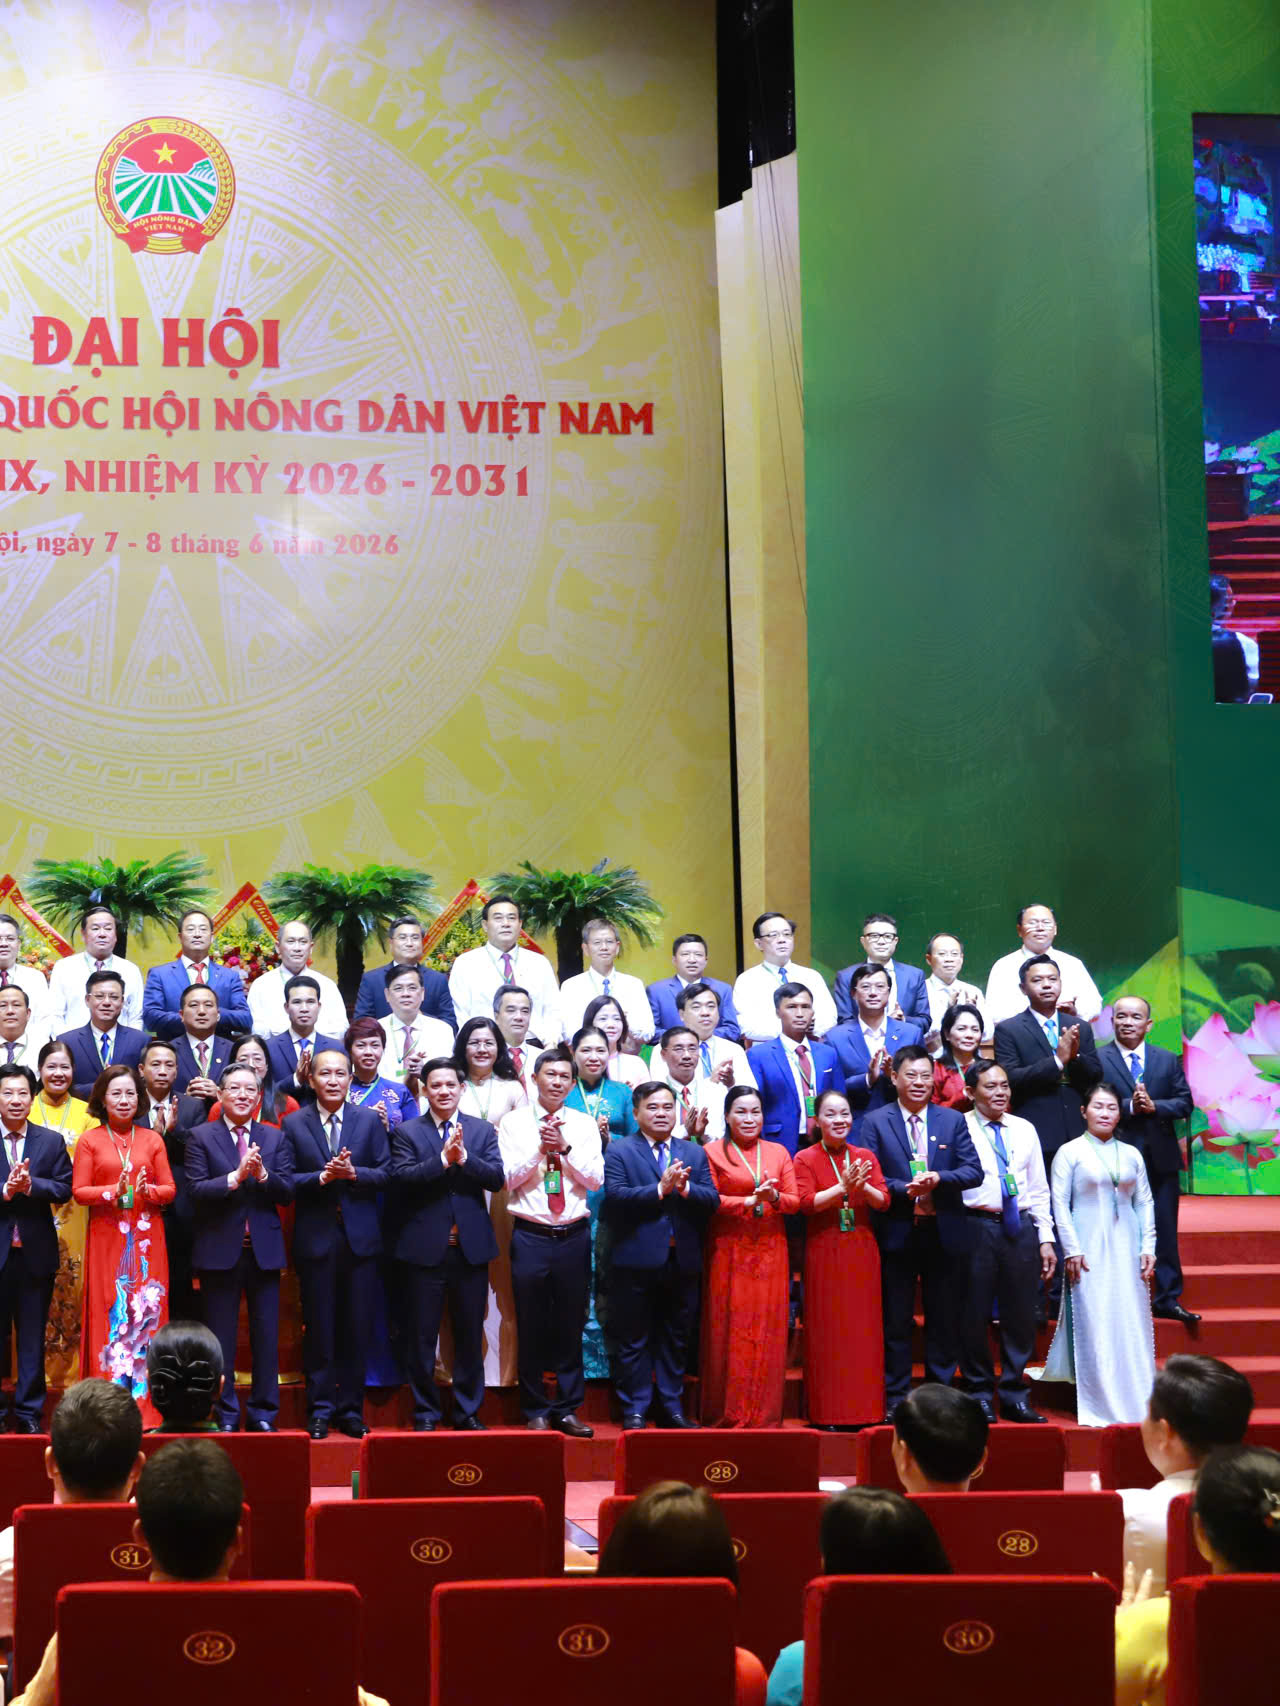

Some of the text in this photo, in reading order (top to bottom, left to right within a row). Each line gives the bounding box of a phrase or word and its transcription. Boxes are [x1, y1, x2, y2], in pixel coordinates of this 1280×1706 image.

[165, 223, 185, 232] NAM
[30, 306, 281, 380] ĐẠI HỘI
[123, 389, 201, 438] HỘI
[214, 391, 345, 433] NÔNG
[359, 392, 446, 433] DÂN
[458, 393, 548, 441] VIỆT
[558, 400, 655, 436] NAM
[64, 452, 200, 501] NHIỆM
[215, 453, 270, 494] KỲ
[283, 461, 387, 495] 2026
[401, 480, 416, 488] -
[429, 463, 529, 497] 2031
[36, 532, 95, 557] ngày
[104, 531, 120, 553] 7
[146, 531, 162, 553] 8
[170, 532, 240, 559] tháng
[249, 533, 264, 554] 6
[273, 534, 325, 555] năm
[333, 533, 400, 555] 2026
[454, 1468, 476, 1481] 29
[710, 1466, 732, 1480] 28
[419, 1543, 444, 1559] 30
[1005, 1537, 1030, 1553] 28
[119, 1550, 142, 1565] 31
[569, 1633, 595, 1652] 31
[954, 1630, 983, 1649] 30
[195, 1640, 225, 1659] 32
